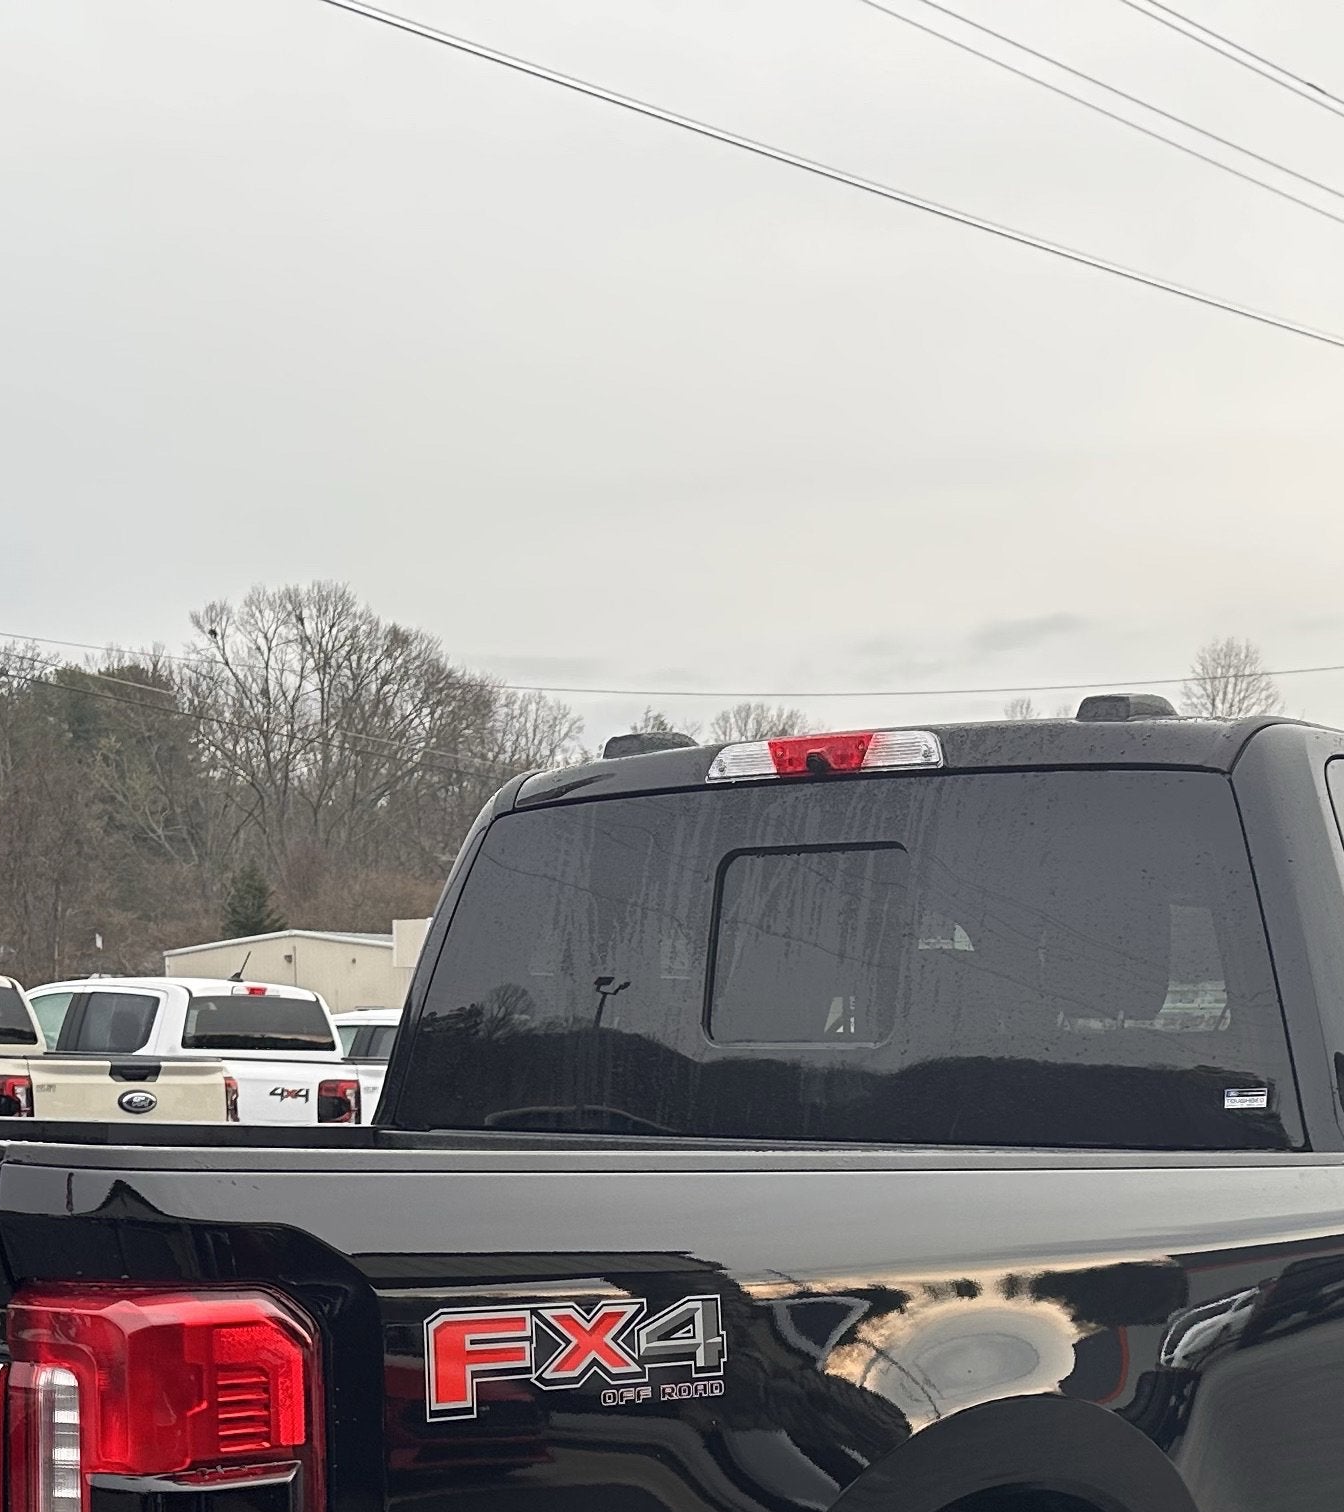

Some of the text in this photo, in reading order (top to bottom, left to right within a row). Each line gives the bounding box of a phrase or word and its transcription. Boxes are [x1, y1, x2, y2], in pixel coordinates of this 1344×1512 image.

[423, 1294, 728, 1423] FX4
[600, 1379, 726, 1407] OFF ROAD
